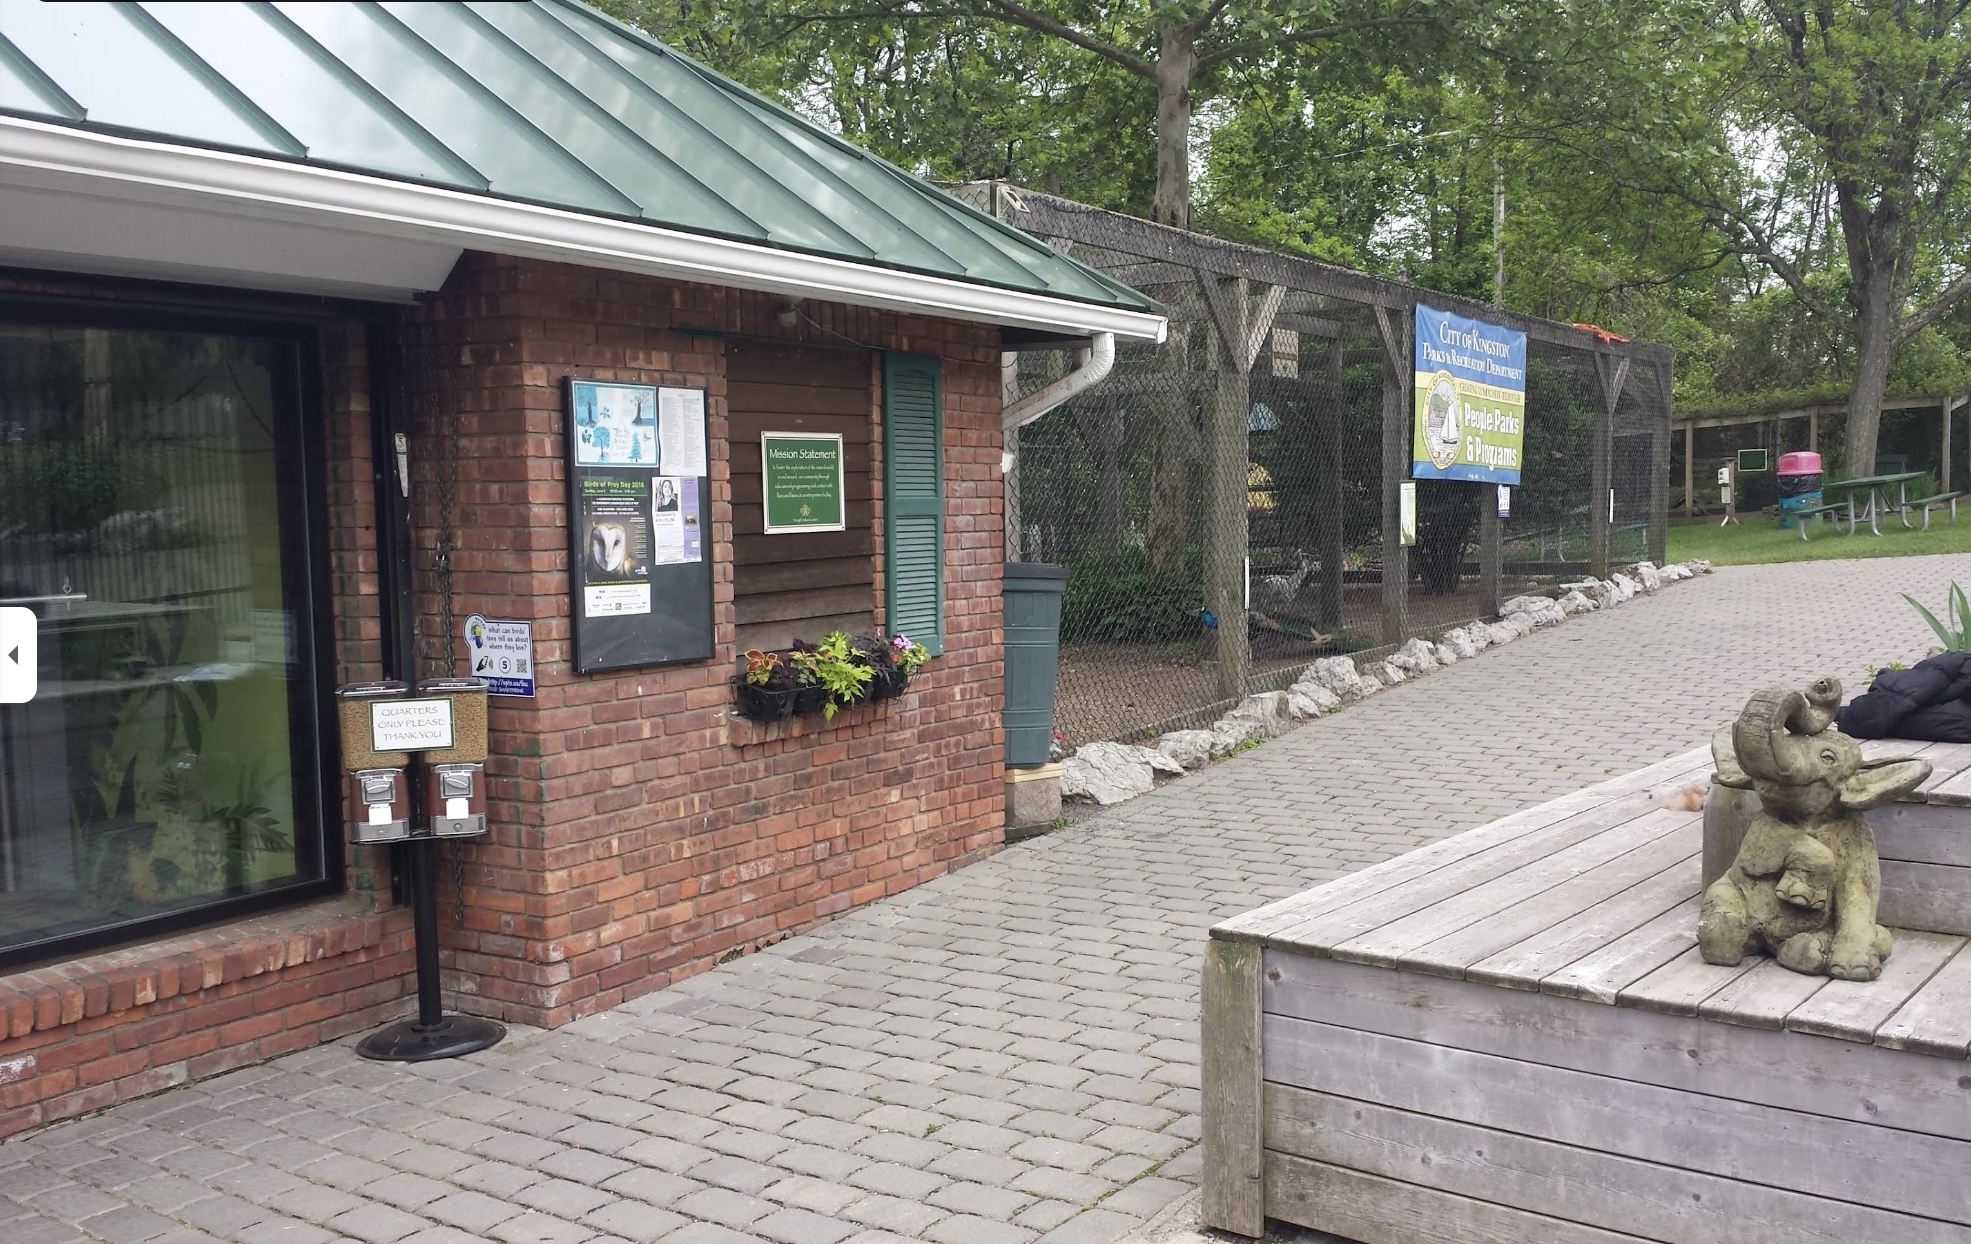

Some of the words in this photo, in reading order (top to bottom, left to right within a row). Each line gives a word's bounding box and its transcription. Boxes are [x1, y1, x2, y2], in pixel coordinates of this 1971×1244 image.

[1440, 321, 1461, 346] CITY
[1462, 333, 1471, 349] OF
[1472, 329, 1510, 358] KINGSTON
[1423, 342, 1446, 363] PARKS
[1486, 358, 1522, 380] DEPARTMENT
[1494, 408, 1519, 435] Parks
[769, 447, 798, 459] Mission
[799, 448, 836, 459] Statement
[1466, 434, 1473, 462] &
[1475, 436, 1517, 471] Programs
[583, 480, 599, 488] Birds
[600, 480, 606, 488] of
[607, 481, 620, 489] Prey
[620, 481, 631, 489] Day
[504, 643, 515, 653] they
[502, 660, 508, 670] 5
[381, 706, 438, 717] QUARTERS
[377, 720, 404, 729] ONLY
[405, 718, 446, 728] PLEASE
[383, 731, 418, 741] THANK
[419, 730, 442, 739] YOU
